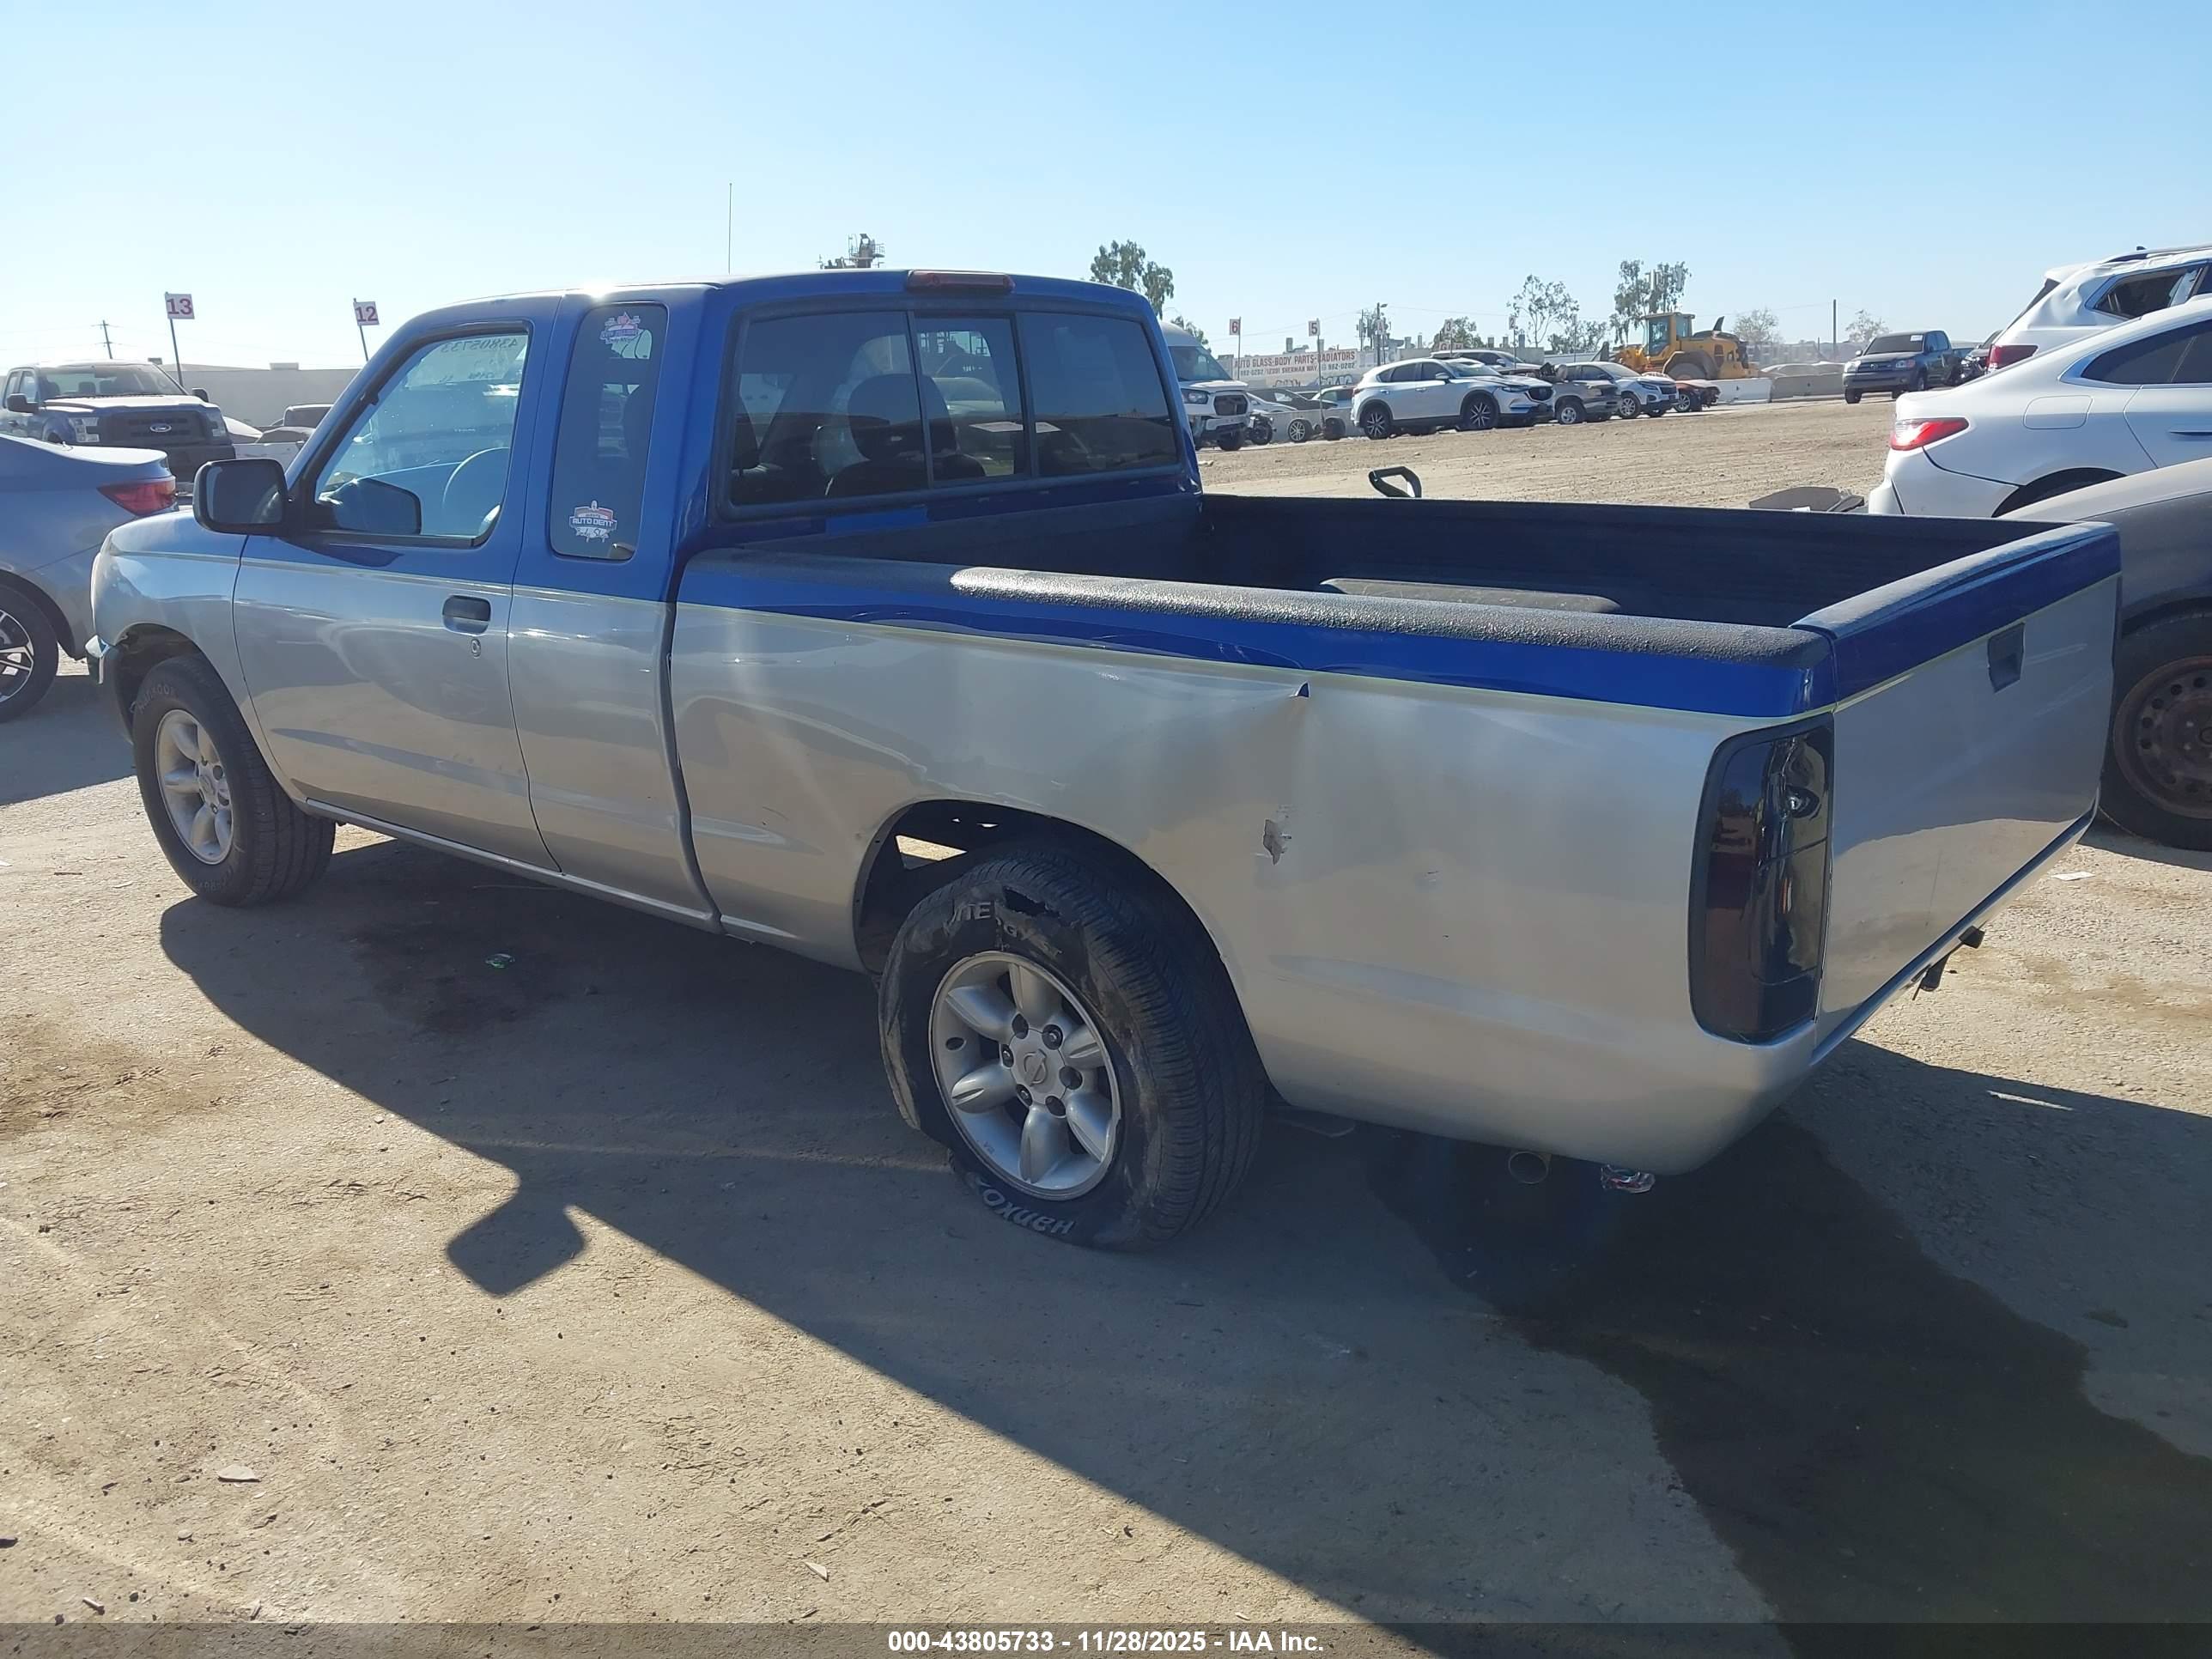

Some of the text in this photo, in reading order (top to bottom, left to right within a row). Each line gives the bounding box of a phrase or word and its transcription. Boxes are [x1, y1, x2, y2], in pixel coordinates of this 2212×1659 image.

[166, 297, 193, 315] 13
[354, 306, 379, 322] 12
[1231, 321, 1238, 334] 6
[1311, 322, 1318, 335] 5
[592, 518, 614, 527] DENT
